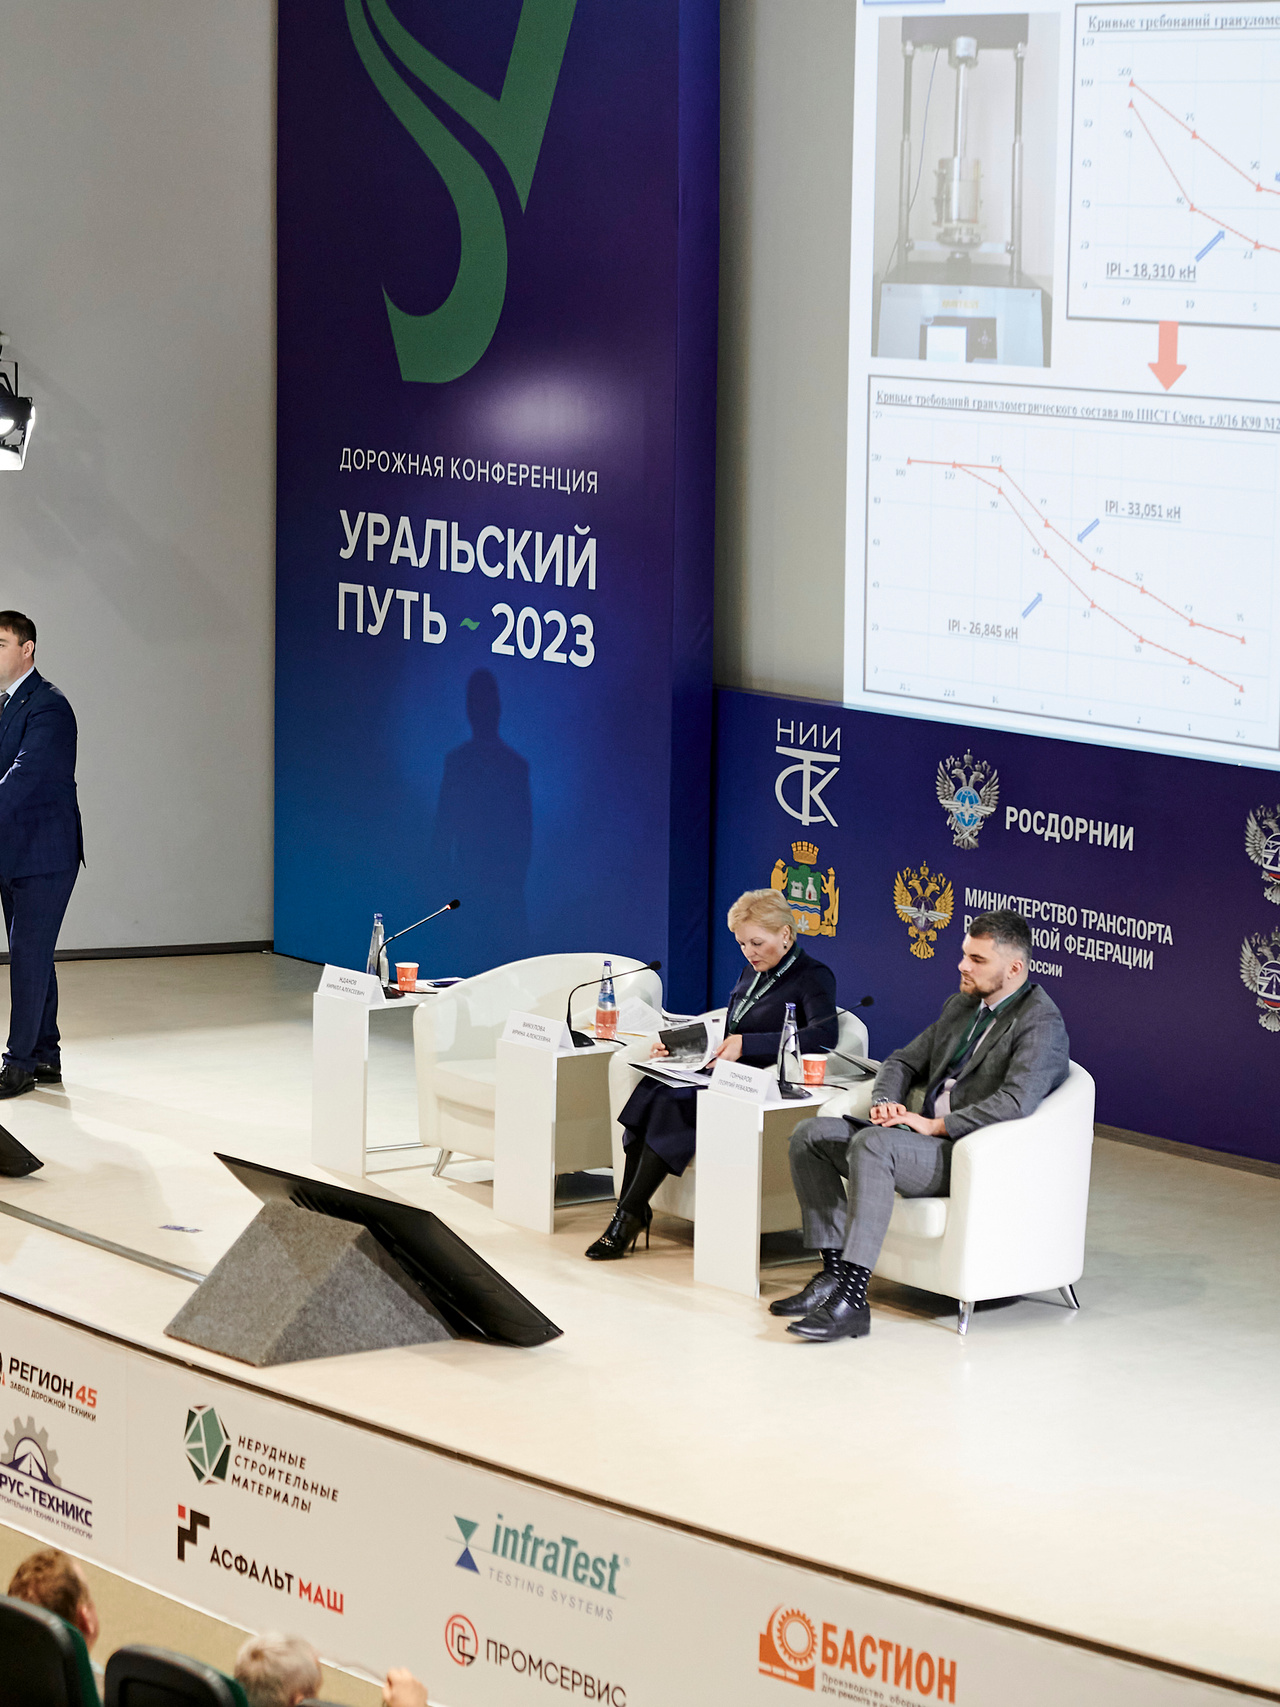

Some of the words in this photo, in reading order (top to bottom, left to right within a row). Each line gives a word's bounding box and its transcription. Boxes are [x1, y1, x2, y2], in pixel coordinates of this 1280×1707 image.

[1106, 262, 1121, 277] IPI
[1133, 263, 1176, 280] 18,310
[1179, 265, 1197, 280] кН
[339, 447, 445, 478] ДОРОЖНАЯ
[450, 456, 599, 496] КОНФЕРЕНЦИЯ
[1105, 499, 1119, 514] IPI
[1127, 501, 1163, 519] 33,051
[1166, 506, 1181, 519] кН
[338, 508, 598, 591] УРАЛЬСКИЙ
[337, 581, 448, 646] ПУТЬ
[491, 601, 596, 669] 2023
[947, 618, 961, 632] IPI
[969, 621, 1003, 638] 26,845
[1004, 627, 1019, 640] кН
[776, 718, 841, 752] НИИ
[1005, 805, 1135, 852] РОСДОРНИИ
[964, 887, 1078, 928] МИНИСТЕРСТВО
[1080, 908, 1174, 946] ТРАНСПОРТА
[1063, 933, 1154, 971] ФЕДЕРАЦИИ
[9, 1357, 74, 1399] РЕГИОН
[75, 1384, 98, 1408] 45
[9, 1381, 30, 1396] ЗАВОД
[31, 1390, 66, 1410] ДОРОЖНОЙ
[68, 1404, 97, 1422] ТЕХНИКИ
[237, 1435, 307, 1471] НЕРУДНЫЕ
[231, 1473, 312, 1514] МАТЕРИАЛЫ
[234, 1455, 339, 1503] СТРОИТЕЛЬНЫЕ
[492, 1513, 621, 1596] infraTest
[210, 1545, 295, 1595] АСФАЛЬТ
[298, 1577, 344, 1615] МАШ
[488, 1567, 545, 1598] TESTING
[550, 1589, 614, 1622] SYSTEMS
[486, 1638, 628, 1707] ПРОМСЕРВИС
[821, 1620, 958, 1705] БАСТИОН
[821, 1684, 837, 1695] для
[838, 1691, 872, 1707] ремонта
[822, 1672, 885, 1701] Производство
